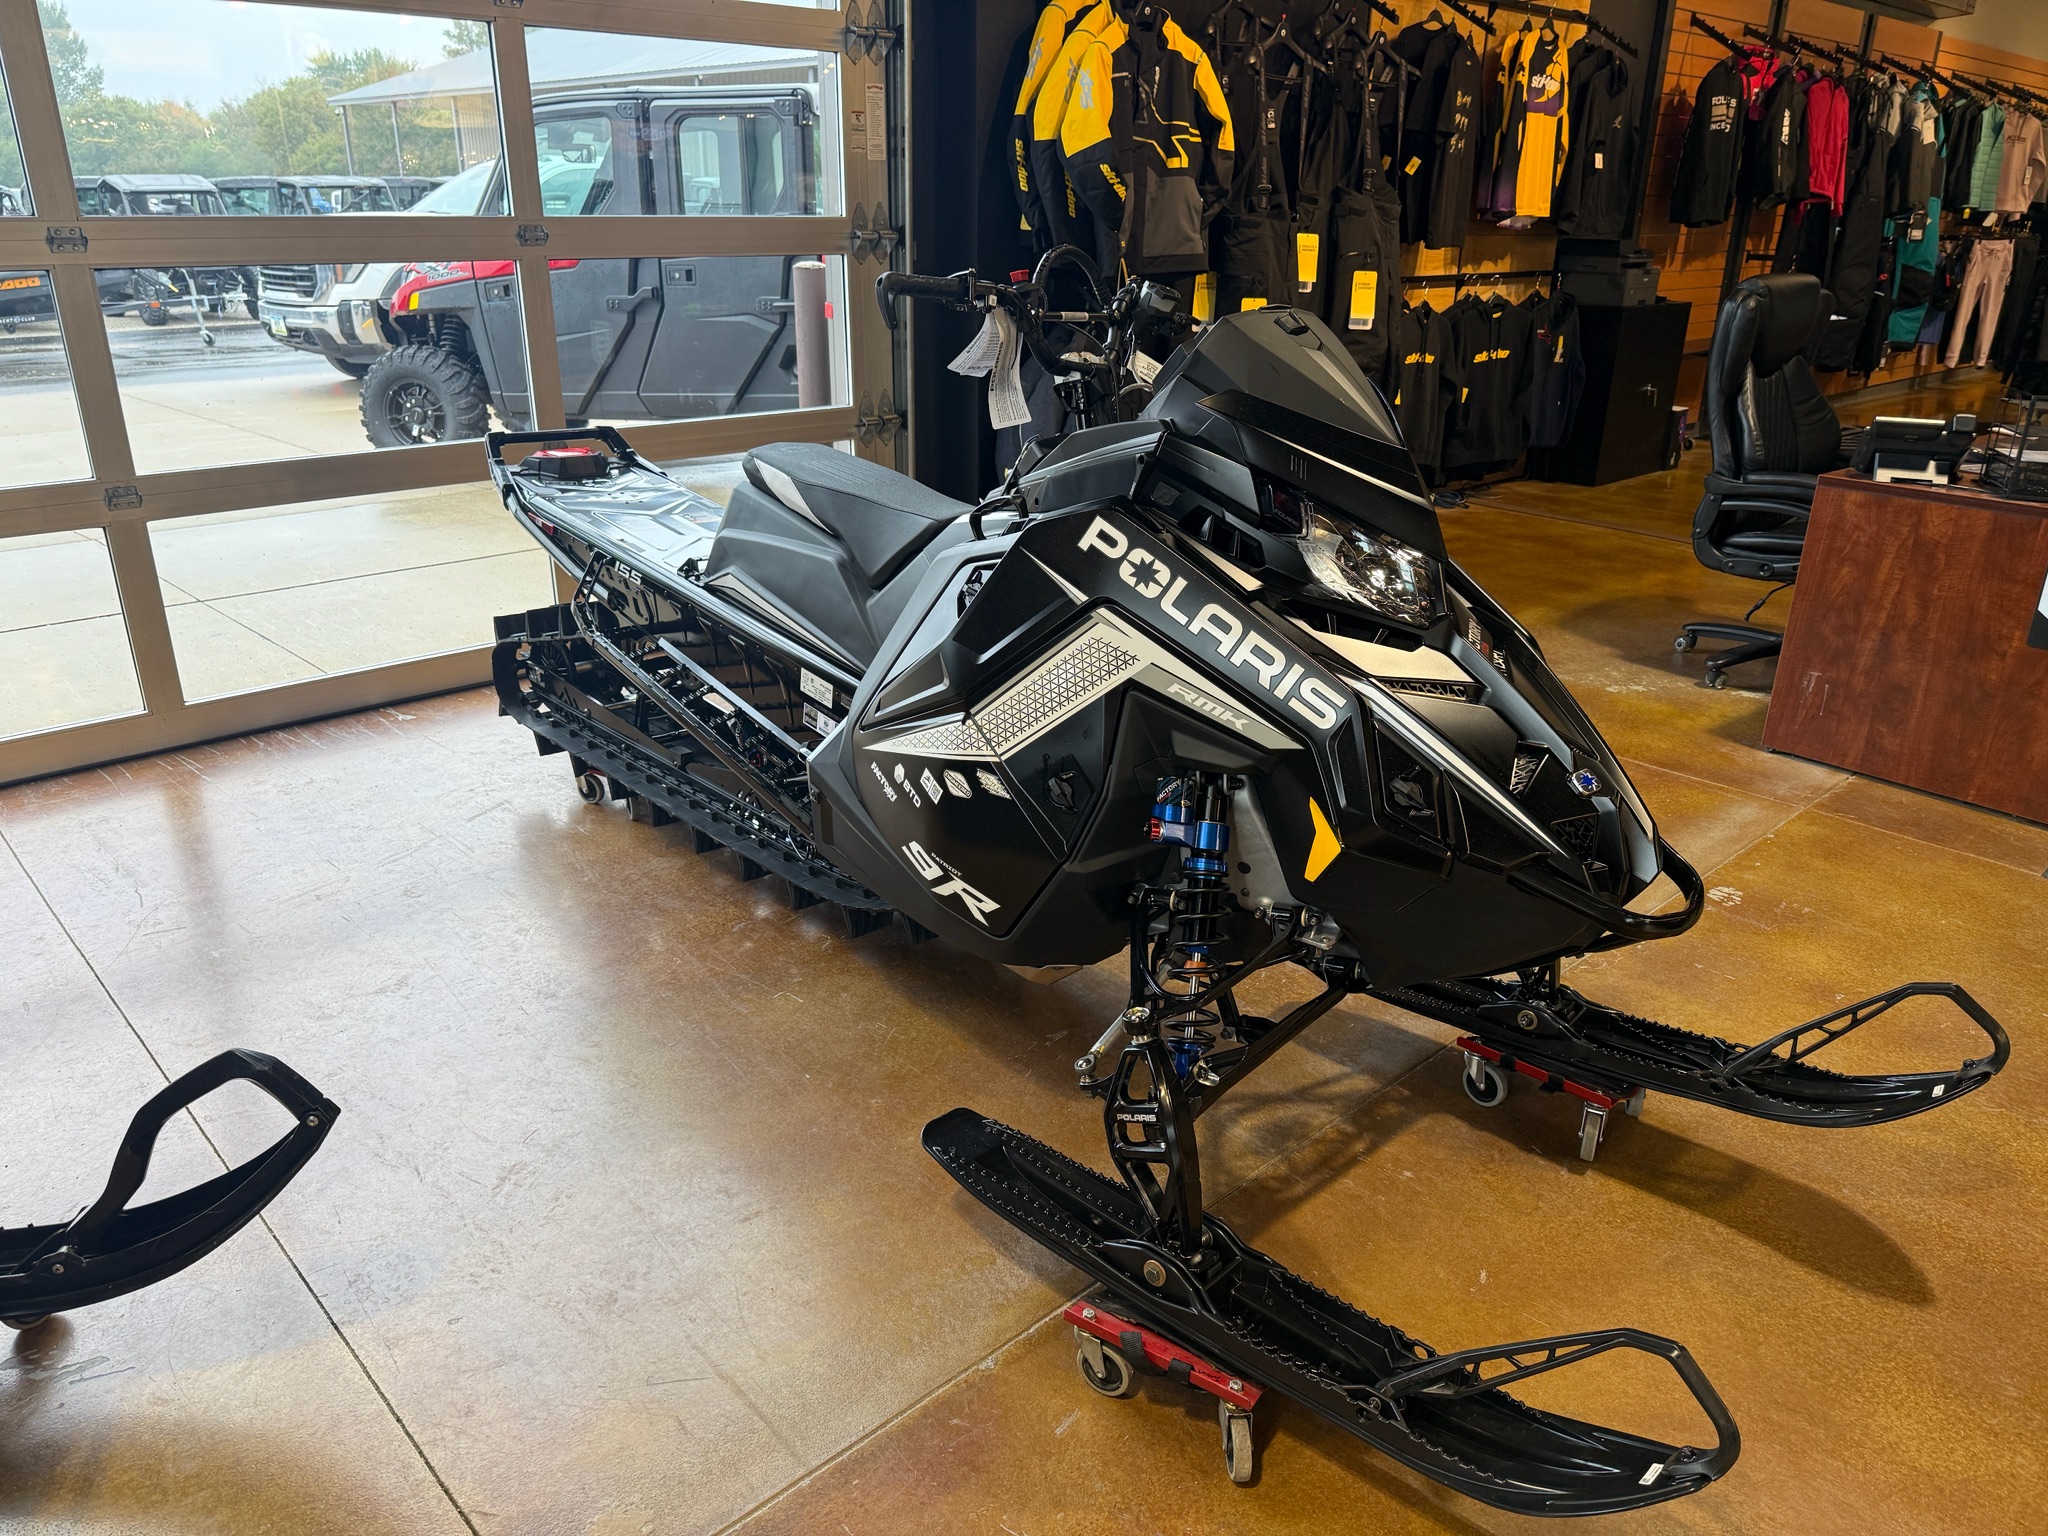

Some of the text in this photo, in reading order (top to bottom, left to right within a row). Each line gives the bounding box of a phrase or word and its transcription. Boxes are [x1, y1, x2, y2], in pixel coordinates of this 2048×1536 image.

[1079, 68, 1094, 109] XPS
[1015, 138, 1028, 192] ski-doo
[1064, 169, 1076, 218] ki-doo
[428, 269, 459, 281] 1000
[614, 560, 643, 586] 155
[1078, 516, 1347, 730] POLARIS
[1166, 682, 1249, 731] RMK
[1157, 779, 1181, 802] FACTORY
[932, 851, 962, 877] PATRIOT
[1116, 1113, 1157, 1122] POLARIS
